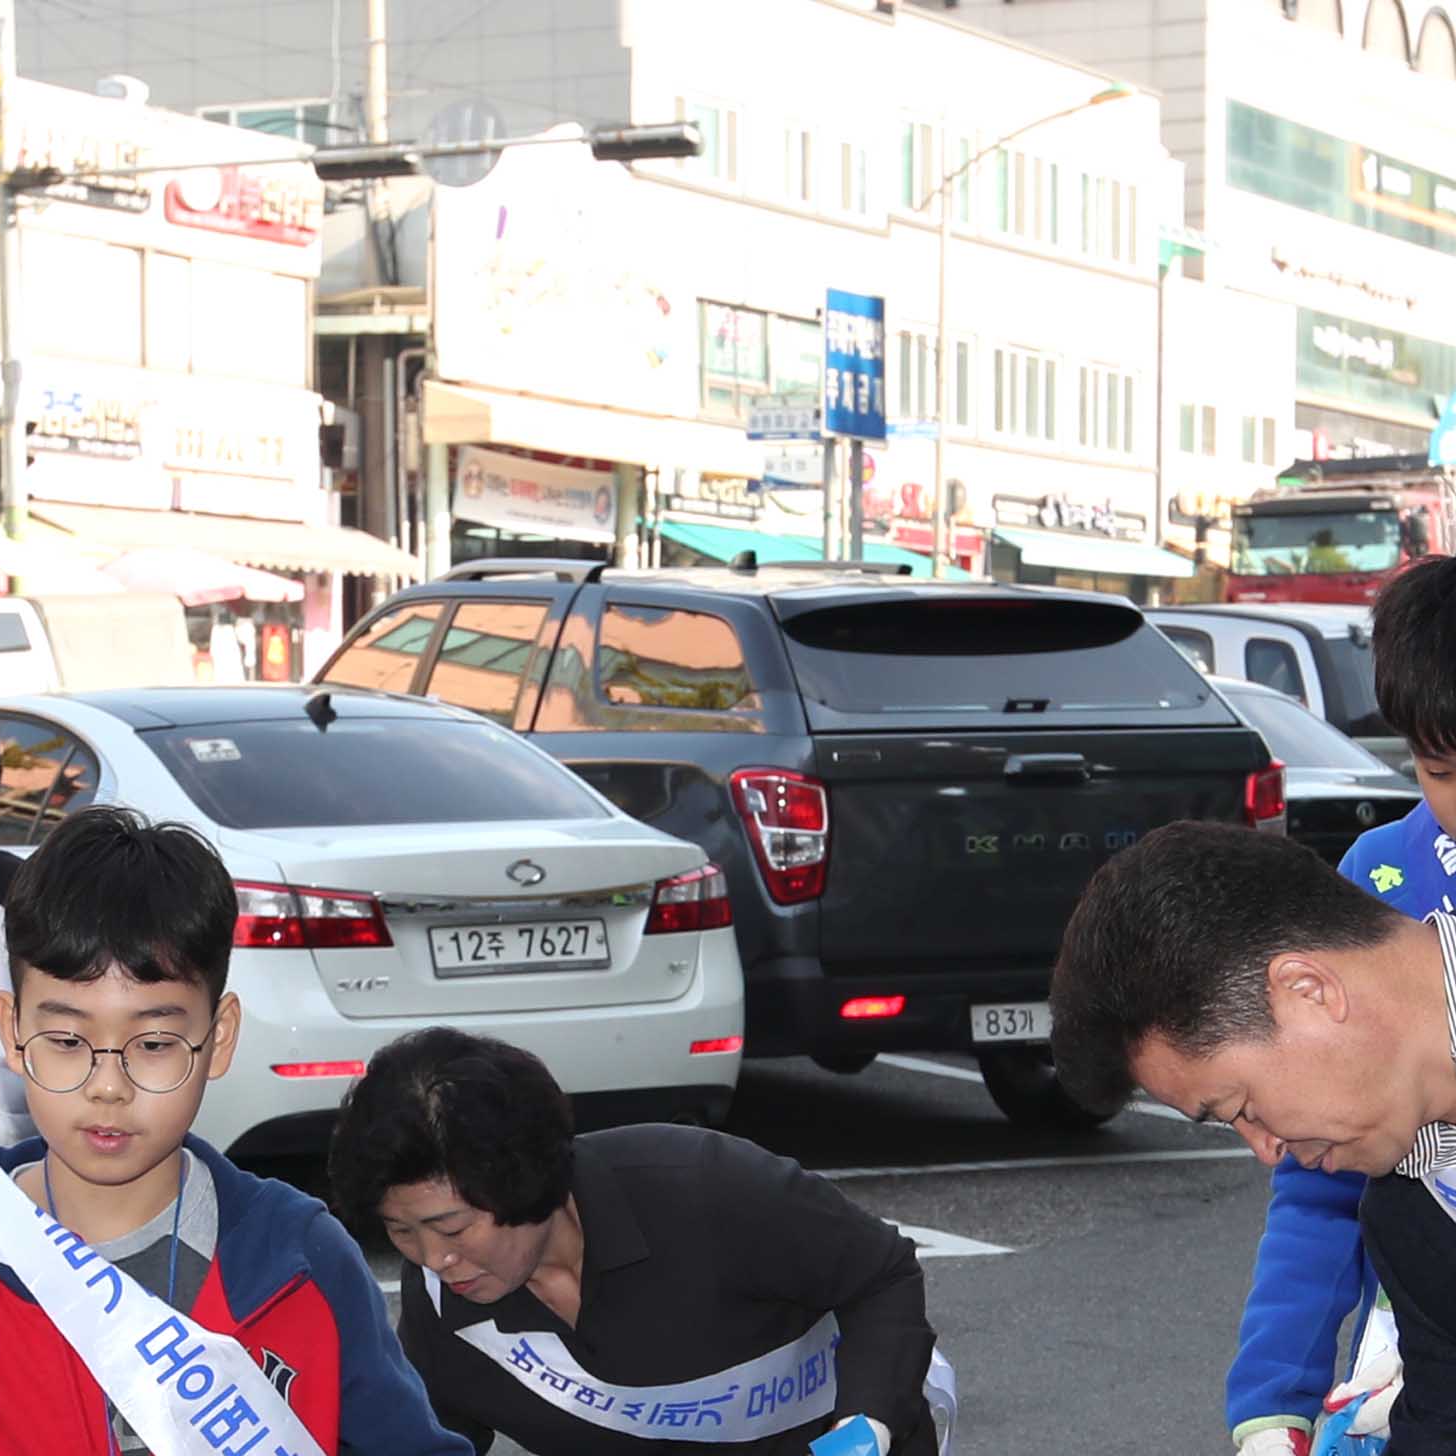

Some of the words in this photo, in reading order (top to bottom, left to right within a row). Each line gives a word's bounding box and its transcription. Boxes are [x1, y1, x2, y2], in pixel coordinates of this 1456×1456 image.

[449, 929, 506, 962] 12주
[517, 925, 591, 958] 7627
[504, 1336, 617, 1412] 버리면
[745, 1348, 828, 1421] 모으면
